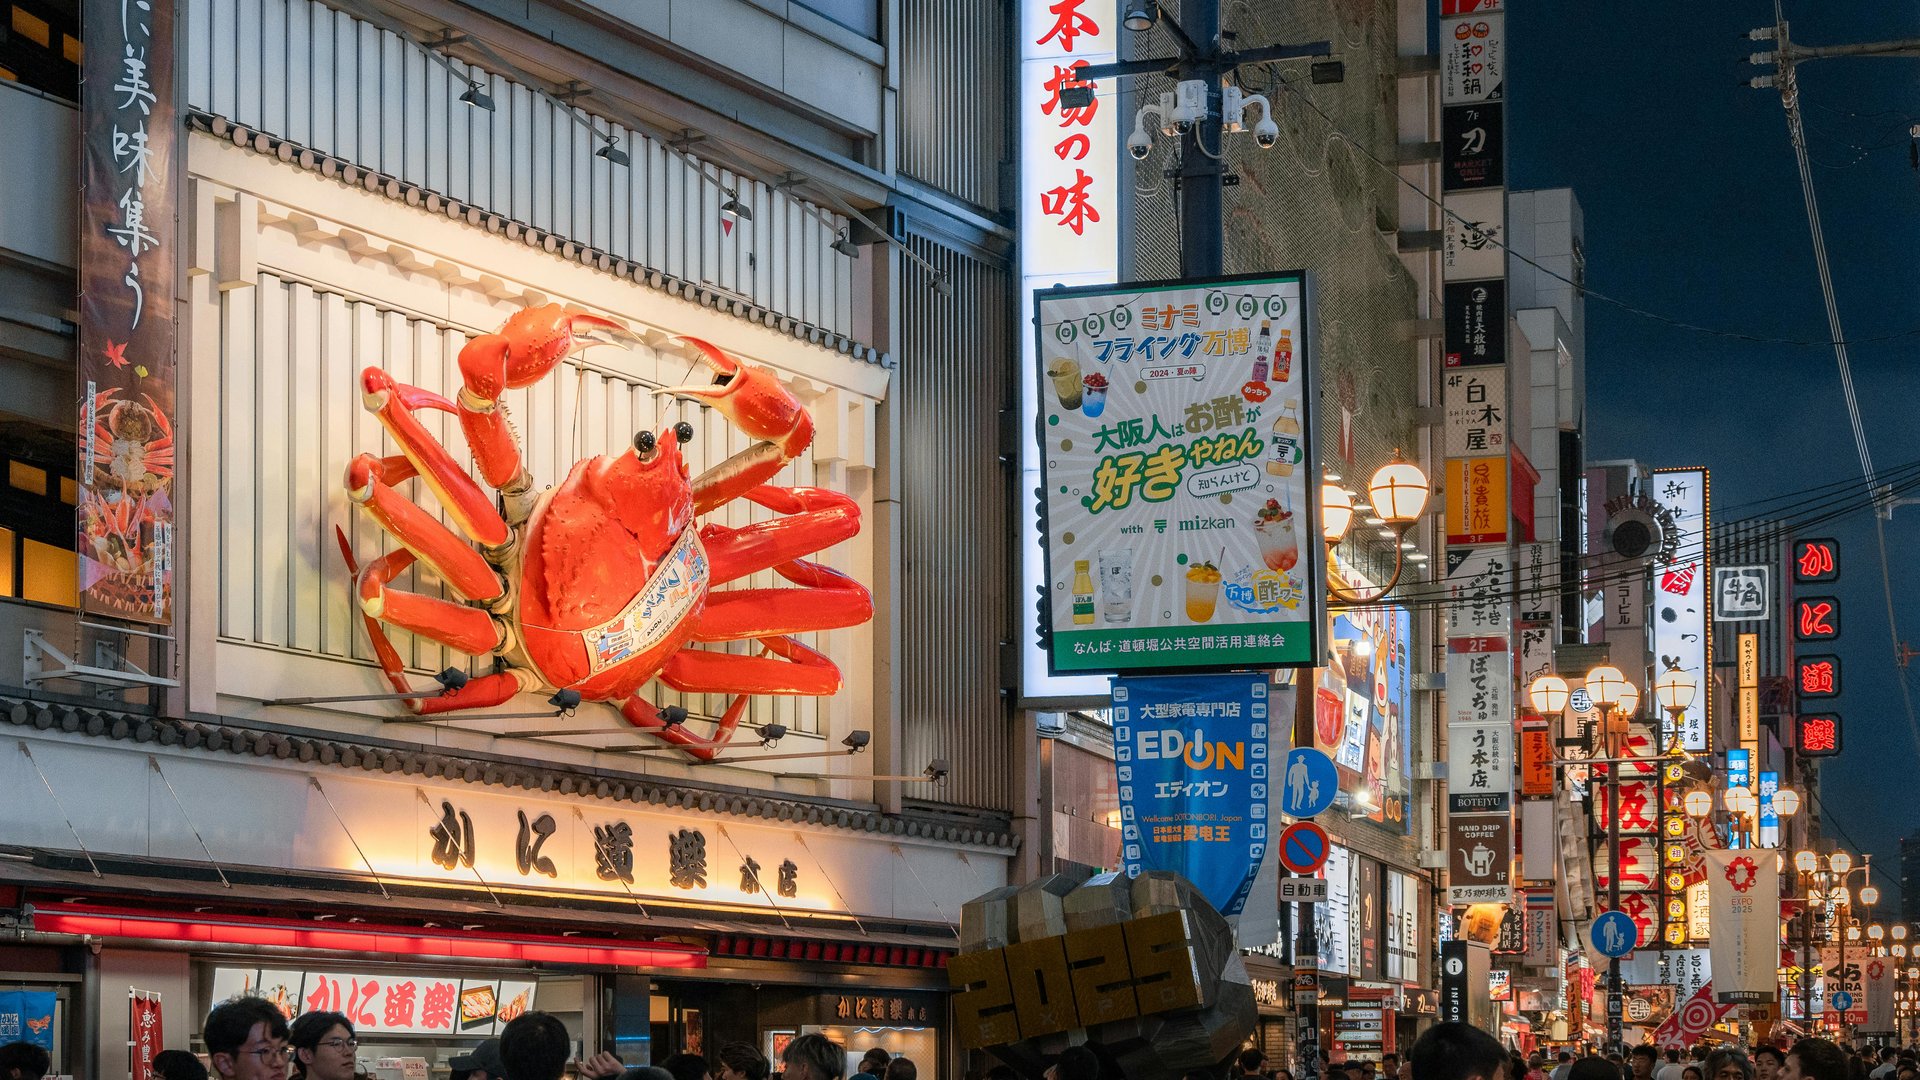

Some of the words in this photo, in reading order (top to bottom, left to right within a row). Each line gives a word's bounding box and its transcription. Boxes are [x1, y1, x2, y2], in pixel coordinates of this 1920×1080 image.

[1467, 110, 1479, 121] 7F
[1462, 127, 1487, 152] 刀
[1141, 303, 1200, 329] ミナミ
[1092, 328, 1251, 363] フライング万博
[1448, 357, 1459, 366] 5F
[1448, 375, 1463, 388] 4F
[1244, 385, 1268, 397] めっちゃ
[1466, 378, 1502, 450] 白木屋
[1198, 470, 1251, 491] 知らんけど
[1473, 462, 1491, 530] 鳥貴族
[1120, 525, 1143, 534] with
[1178, 515, 1236, 531] mizkan
[1470, 535, 1484, 543] 3F
[1449, 554, 1461, 565] 3F
[1724, 578, 1763, 606] 牛角
[1469, 639, 1488, 652] 2F
[1140, 702, 1241, 719] 大型家電専門店
[1137, 728, 1245, 771] EDION
[1155, 780, 1229, 798] エディオン
[1457, 797, 1501, 808] BOTEJYU
[1760, 780, 1777, 818] 焼肉
[1220, 814, 1242, 823] Japan
[739, 855, 798, 898] 本店
[1496, 872, 1506, 880] 1F
[1283, 882, 1327, 897] 自動車
[1453, 887, 1507, 899] 星乃珈琲店
[1731, 898, 1753, 906] EXPO
[1731, 906, 1753, 914] 2025
